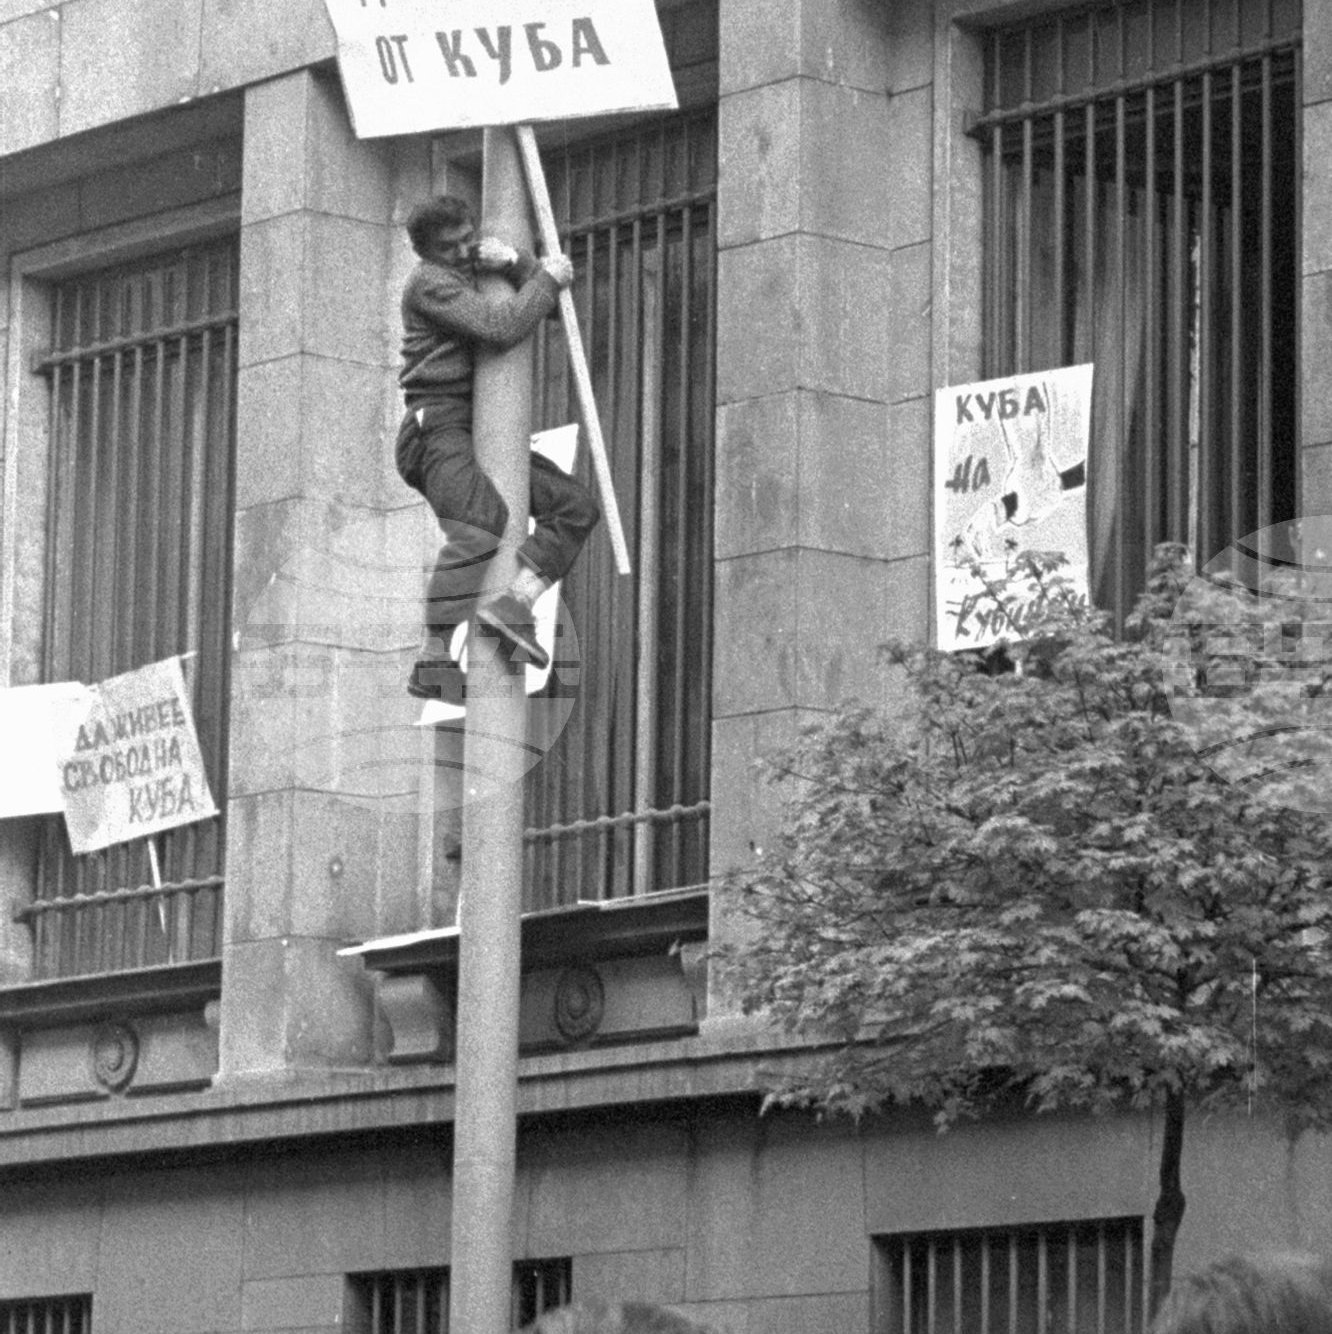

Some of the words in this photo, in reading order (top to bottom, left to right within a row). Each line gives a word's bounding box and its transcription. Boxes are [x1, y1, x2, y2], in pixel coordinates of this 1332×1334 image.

[375, 34, 415, 85] ОТ
[435, 17, 611, 85] КУБА
[956, 386, 1046, 425] КУБА
[63, 735, 183, 792] СВОБОДНА
[129, 773, 196, 824] КУБА
